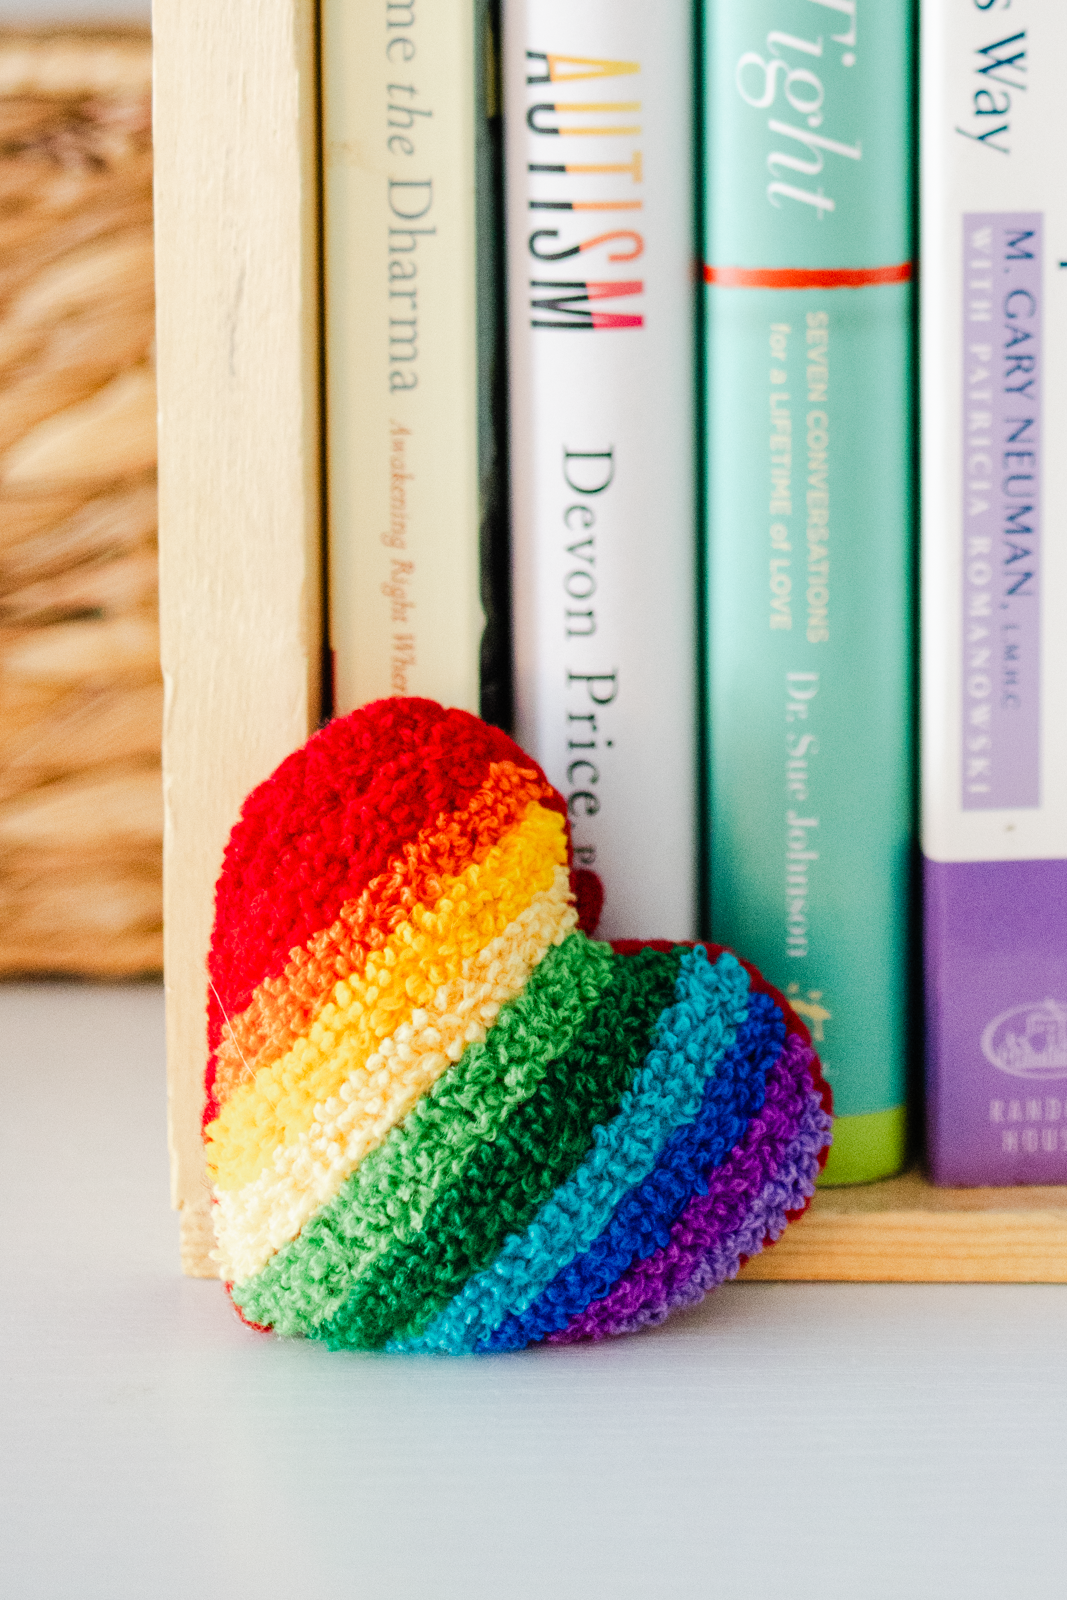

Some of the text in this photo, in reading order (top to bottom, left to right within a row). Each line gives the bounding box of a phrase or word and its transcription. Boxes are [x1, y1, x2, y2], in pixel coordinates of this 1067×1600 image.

[387, 83, 433, 156] the
[526, 49, 645, 329] AUTISM
[955, 30, 1027, 154] Way
[388, 178, 436, 394] Dharma
[1004, 229, 1036, 274] M.
[1004, 289, 1036, 400] GARY
[379, 418, 416, 698] Awakening Right Wher
[562, 444, 614, 640] Devon
[769, 323, 792, 630] for a LIFETIME of LOVE
[806, 311, 829, 643] SEVEN CONVERSATIONS
[967, 227, 992, 794] WITH PATRICIA ROMANOWSKI
[786, 672, 819, 957] Dr. Sue Johnson
